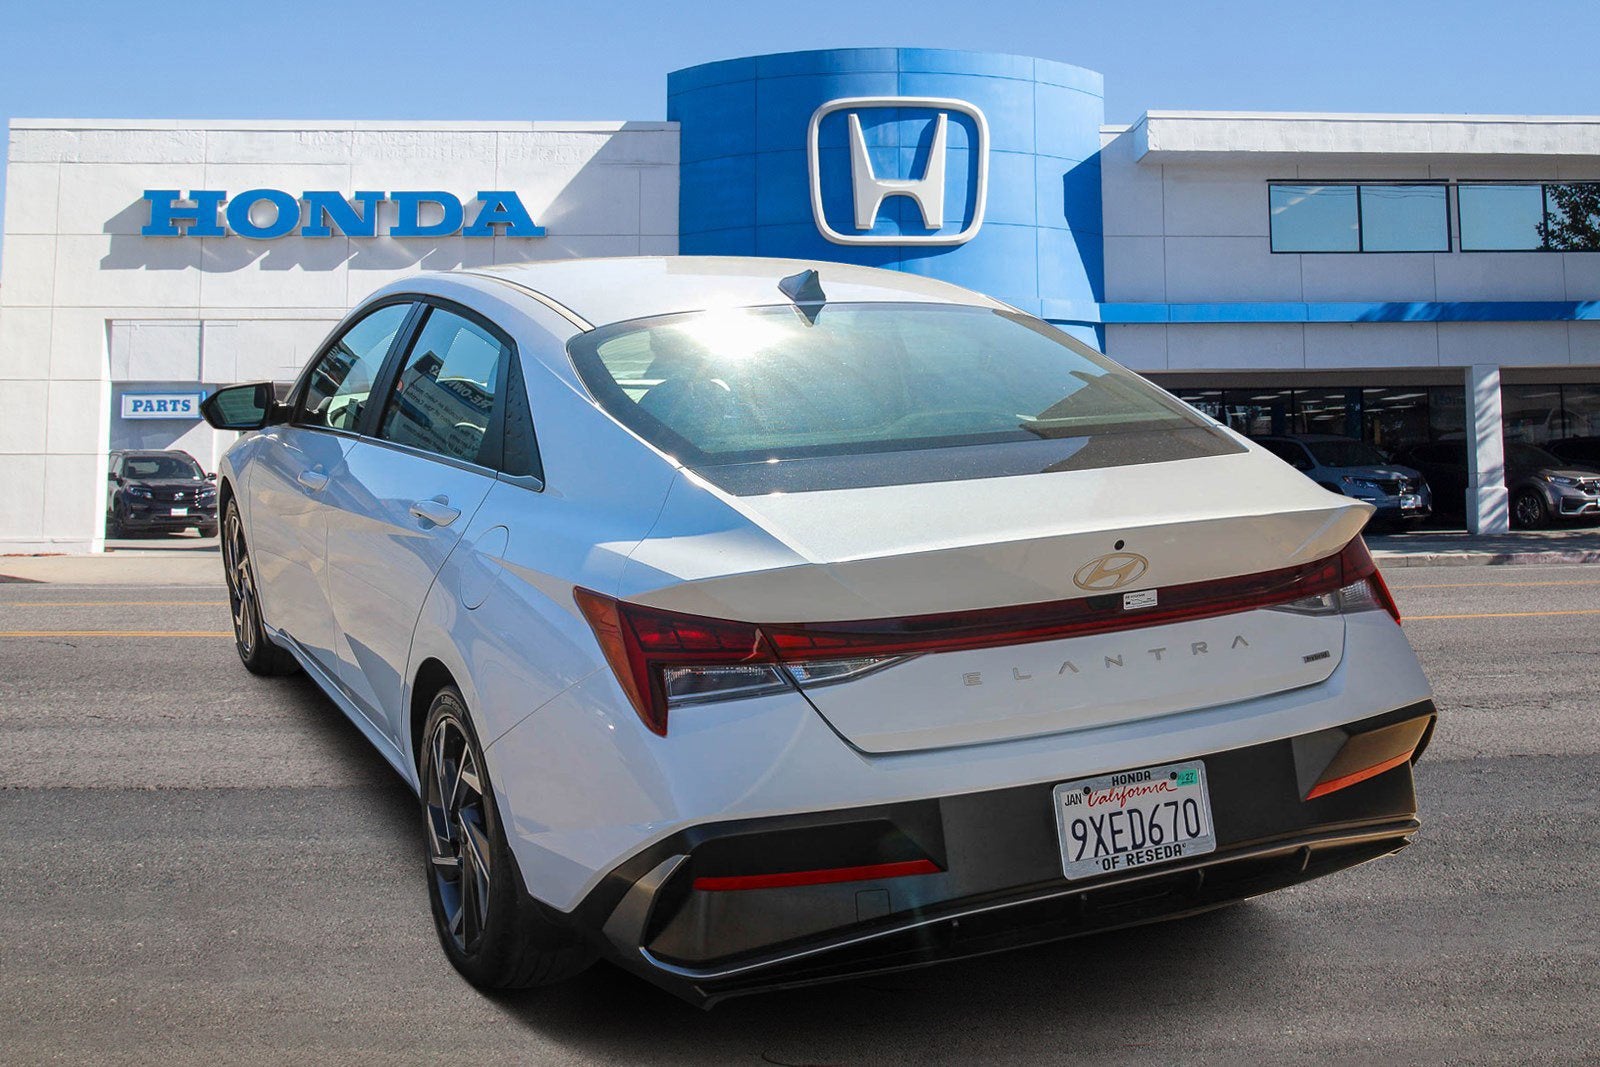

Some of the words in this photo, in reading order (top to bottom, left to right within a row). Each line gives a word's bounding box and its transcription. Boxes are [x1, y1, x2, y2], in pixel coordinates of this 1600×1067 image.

[141, 188, 548, 240] HONDA
[132, 399, 191, 412] PARTS
[963, 634, 1249, 687] ELANTRA
[1064, 793, 1083, 807] JAN
[1088, 782, 1178, 808] California
[1185, 772, 1194, 781] 27
[1112, 771, 1151, 786] HONDA
[1071, 798, 1201, 862] 9XED670
